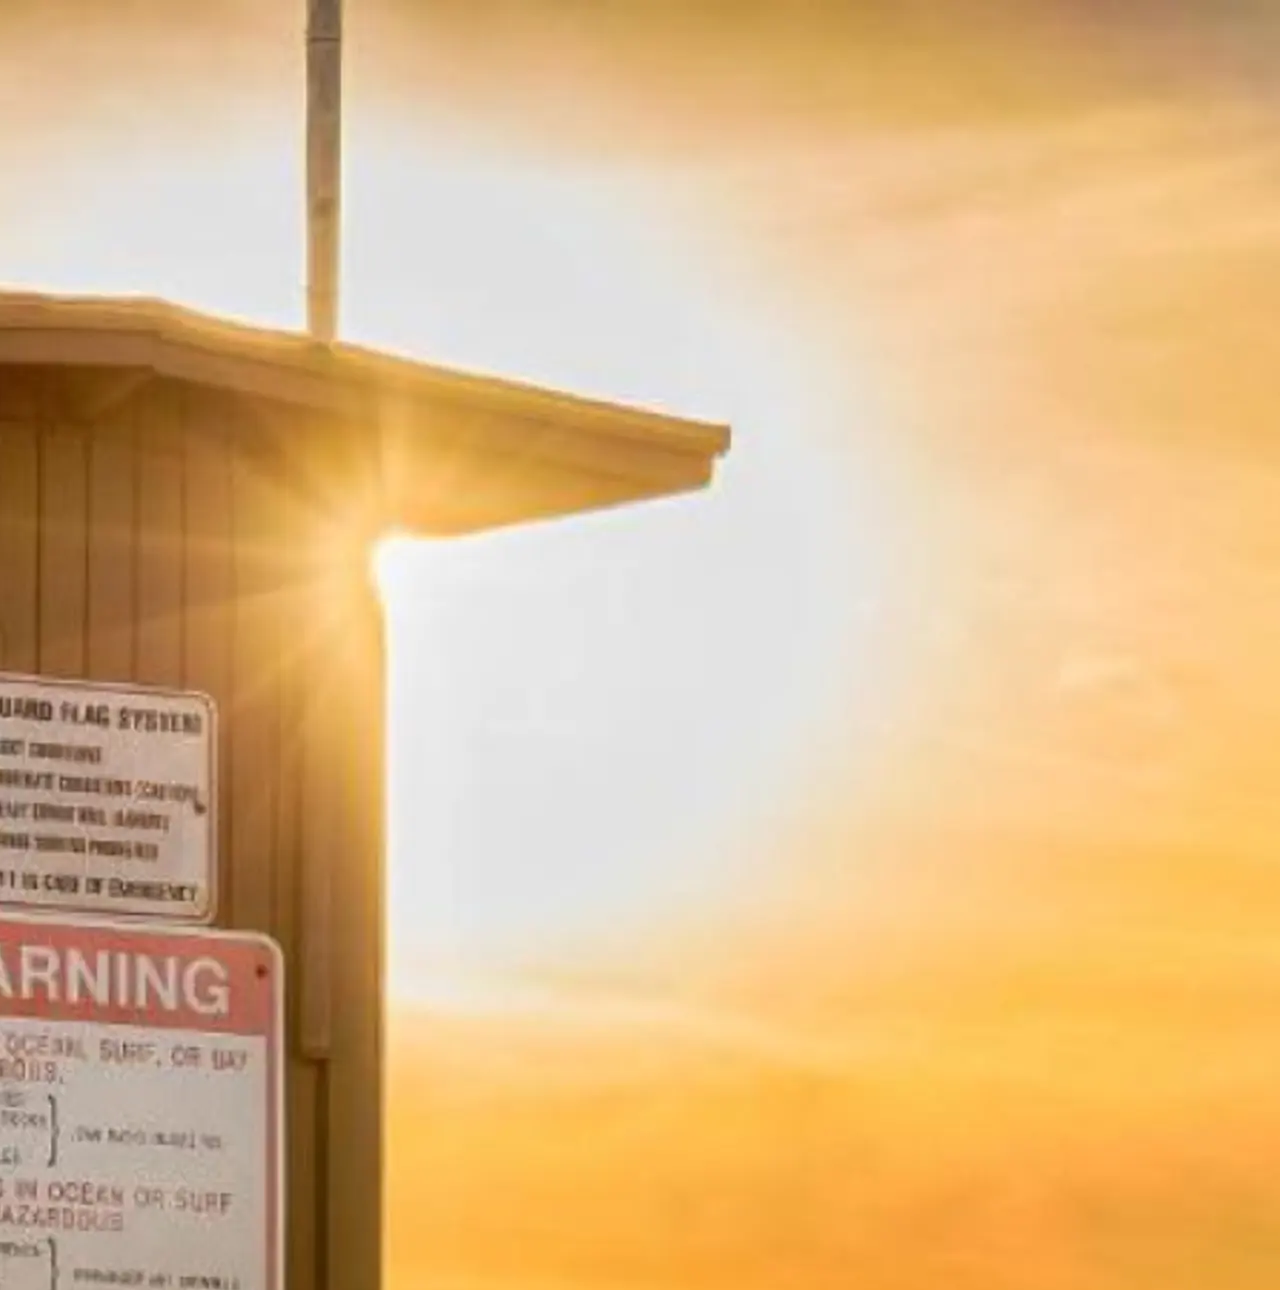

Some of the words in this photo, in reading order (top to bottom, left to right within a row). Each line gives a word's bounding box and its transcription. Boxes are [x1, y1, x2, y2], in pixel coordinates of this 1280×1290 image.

[60, 701, 110, 729] FLAG
[118, 706, 202, 734] SYSTEM
[171, 1044, 201, 1068] OR
[14, 1179, 38, 1199] IN
[48, 1181, 124, 1206] OCEAN
[133, 1186, 164, 1211] OR
[175, 1188, 234, 1216] SURF
